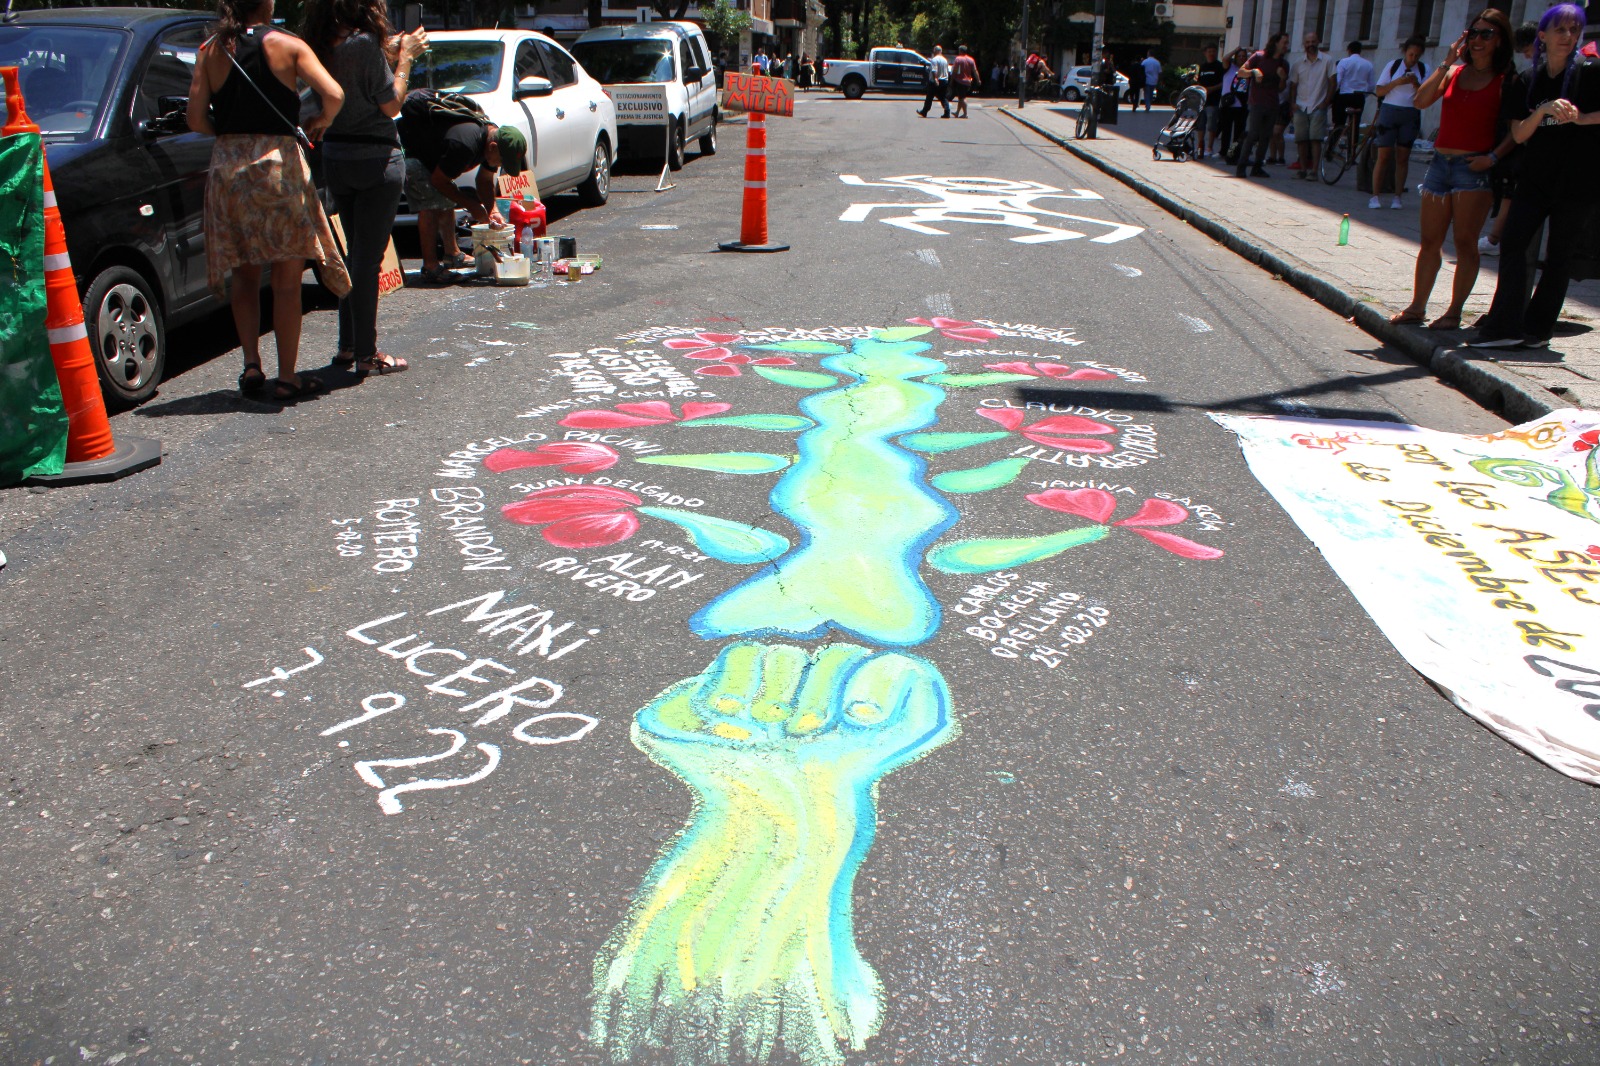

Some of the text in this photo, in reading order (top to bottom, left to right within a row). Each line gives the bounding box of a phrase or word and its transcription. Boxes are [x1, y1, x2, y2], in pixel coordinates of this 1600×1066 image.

[617, 102, 662, 111] EXCLUSIVO
[726, 74, 778, 96] FUERA
[503, 175, 530, 194] LUCHAR
[587, 347, 661, 386] CASTRO
[625, 350, 700, 394] EZEQUIEL
[943, 349, 1061, 360] GRACIELA
[516, 391, 716, 419] WALTER CAMPOS
[980, 398, 1134, 423] CLAUDIO
[434, 431, 664, 479] MARCELO PACINI
[1366, 441, 1456, 471] por
[1434, 480, 1511, 511] las
[510, 477, 704, 508] JUAN DELGADO
[372, 498, 422, 573] ROMERO
[431, 486, 512, 571] BRANDON
[592, 552, 704, 589] ALAN
[1342, 460, 1589, 652] de Diciembre de
[536, 556, 656, 601] RIVERO
[954, 571, 1019, 616] CARLOS
[966, 581, 1053, 642] BOCACHA
[990, 591, 1081, 659] ORELLANO
[345, 611, 600, 745] LUCERO
